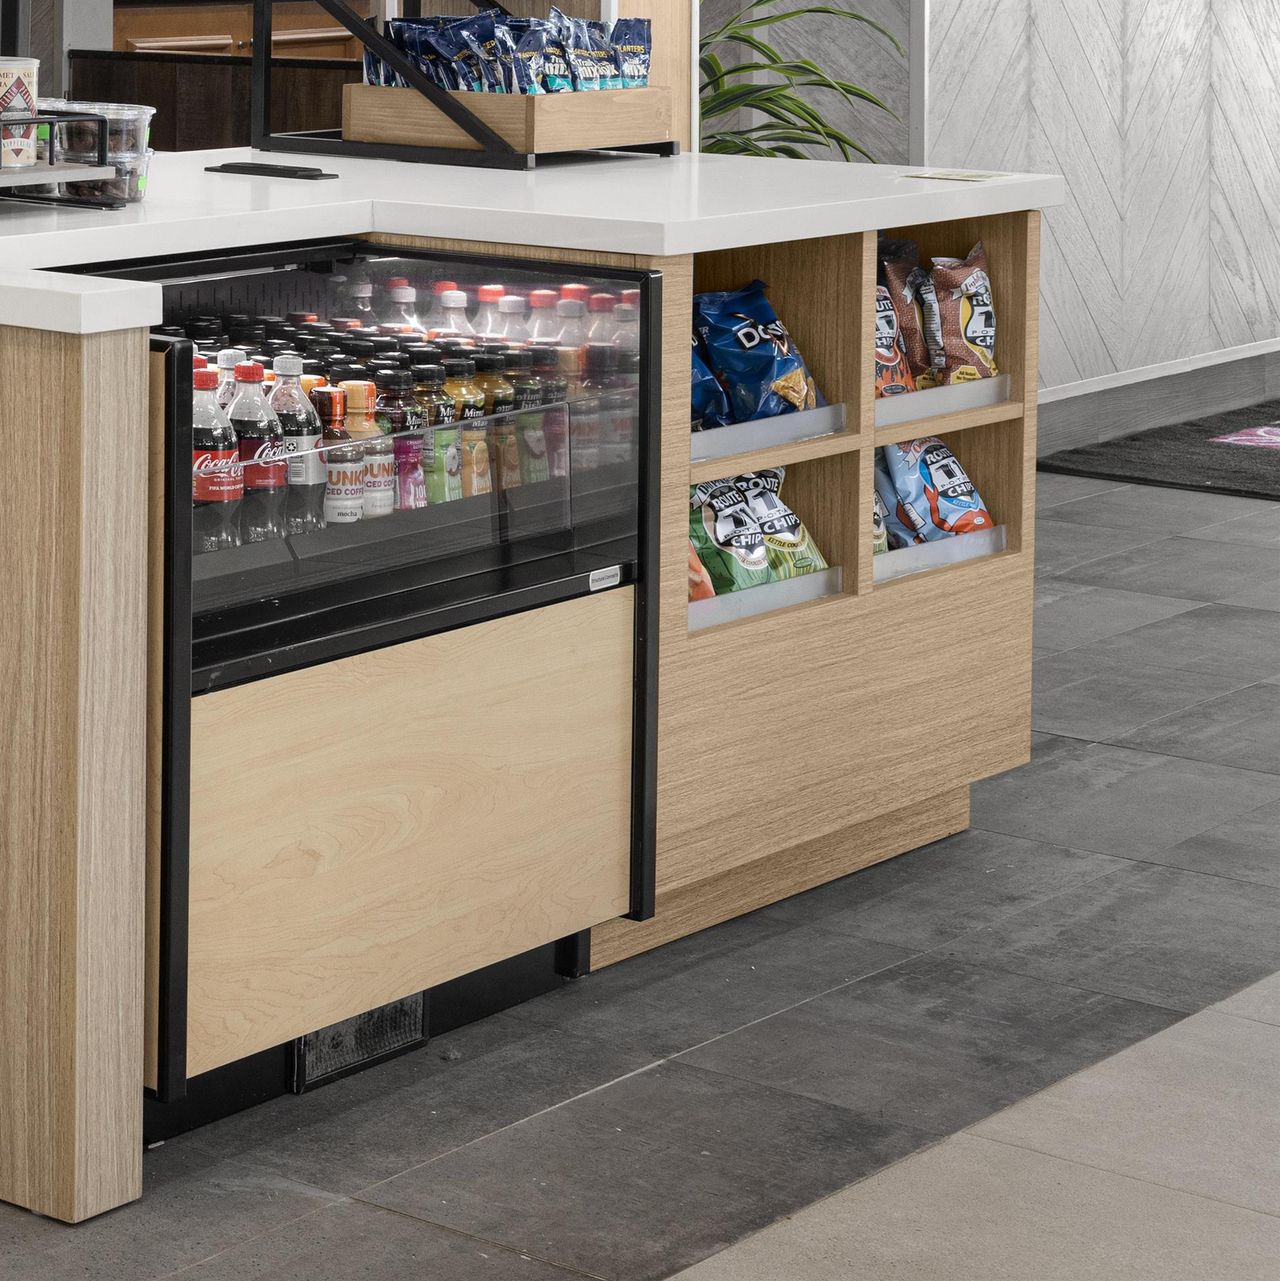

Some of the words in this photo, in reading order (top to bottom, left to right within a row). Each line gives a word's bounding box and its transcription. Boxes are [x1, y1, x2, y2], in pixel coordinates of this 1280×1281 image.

[876, 299, 893, 311] UTE
[463, 407, 485, 418] Minu
[327, 470, 364, 487] UNK
[736, 477, 779, 492] ROUTE
[344, 488, 364, 496] COFF
[711, 490, 743, 510] ROUTE
[337, 510, 358, 518] mocha
[763, 513, 800, 534] CHIPS
[730, 533, 762, 546] CHIP
